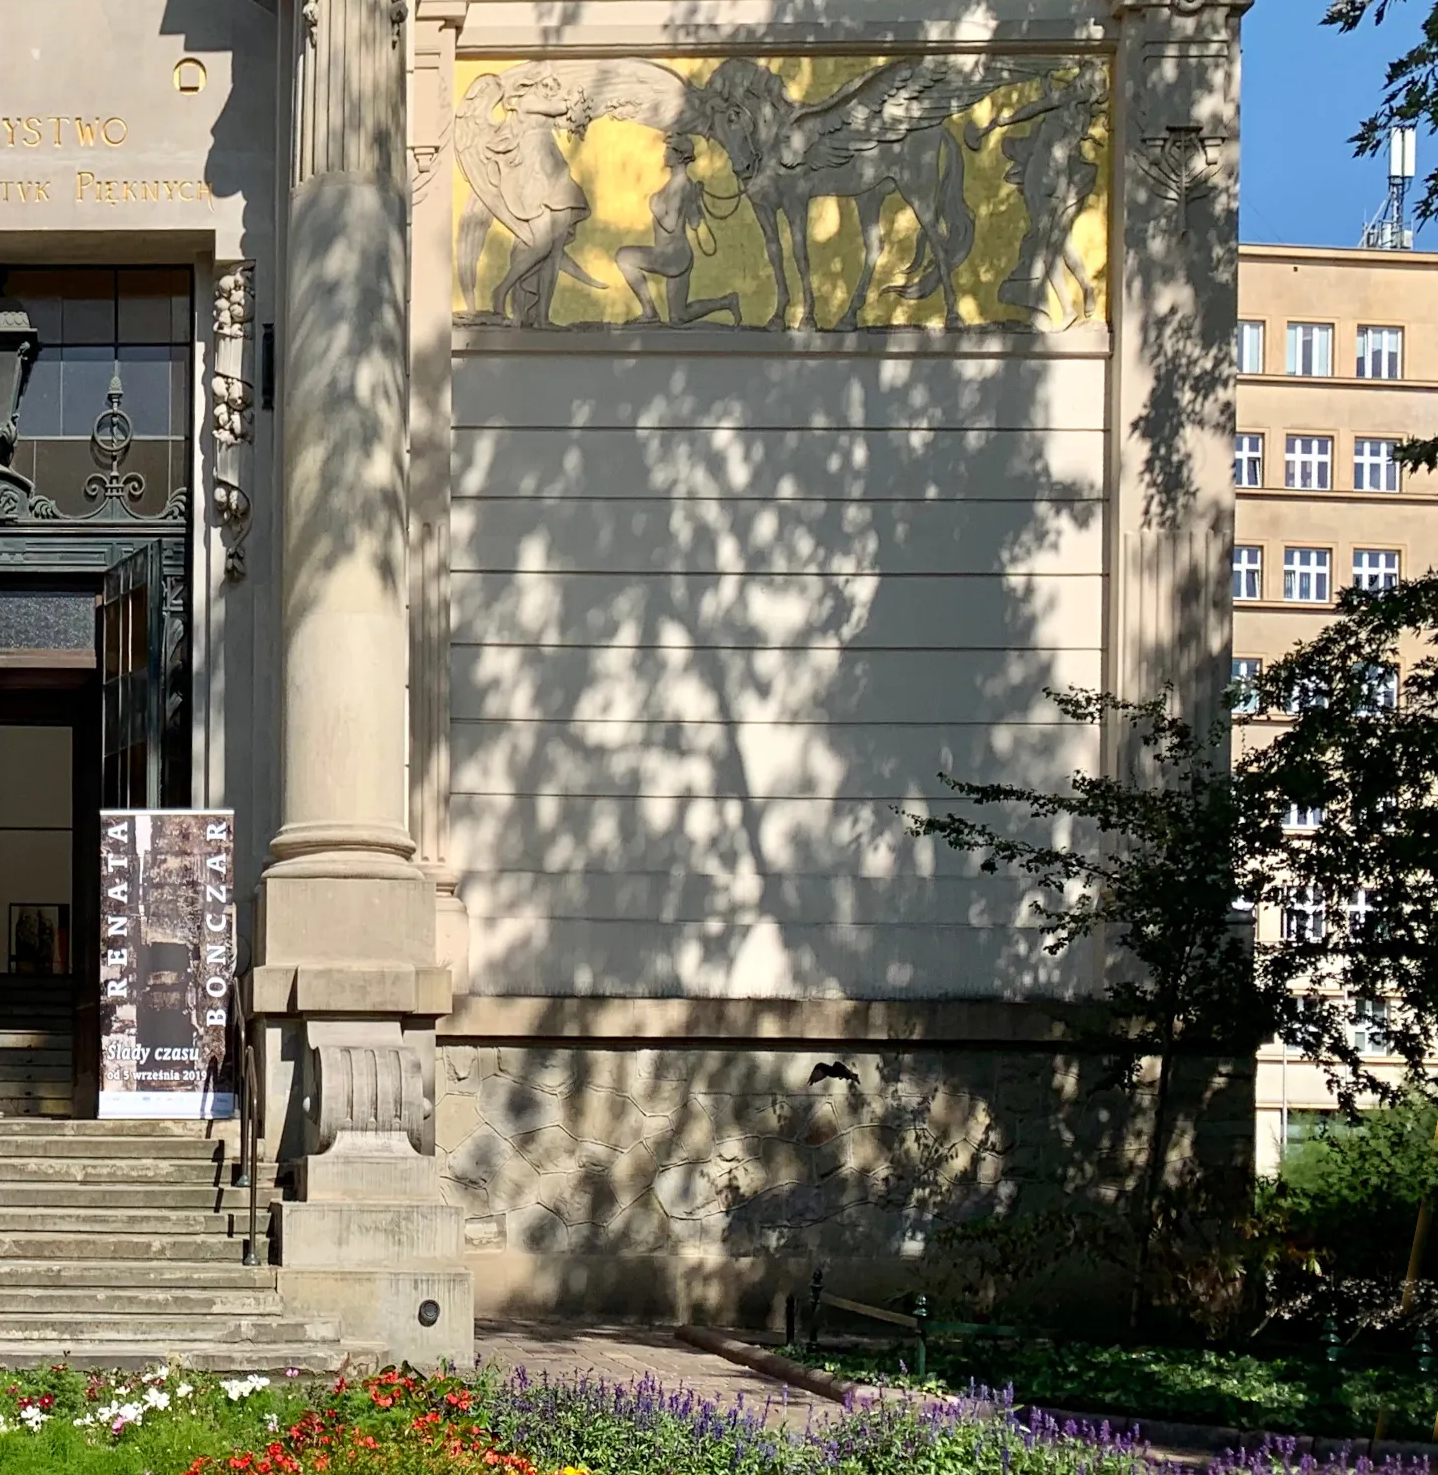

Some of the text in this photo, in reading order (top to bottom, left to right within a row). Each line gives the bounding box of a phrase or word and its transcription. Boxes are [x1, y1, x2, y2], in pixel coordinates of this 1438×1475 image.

[76, 171, 215, 213] PIĘKNYCH
[107, 821, 128, 999] RENATA
[206, 821, 227, 1028] BONCZAR
[107, 1040, 200, 1065] Ślady czasu
[107, 1069, 208, 1081] od 5 września 2019
